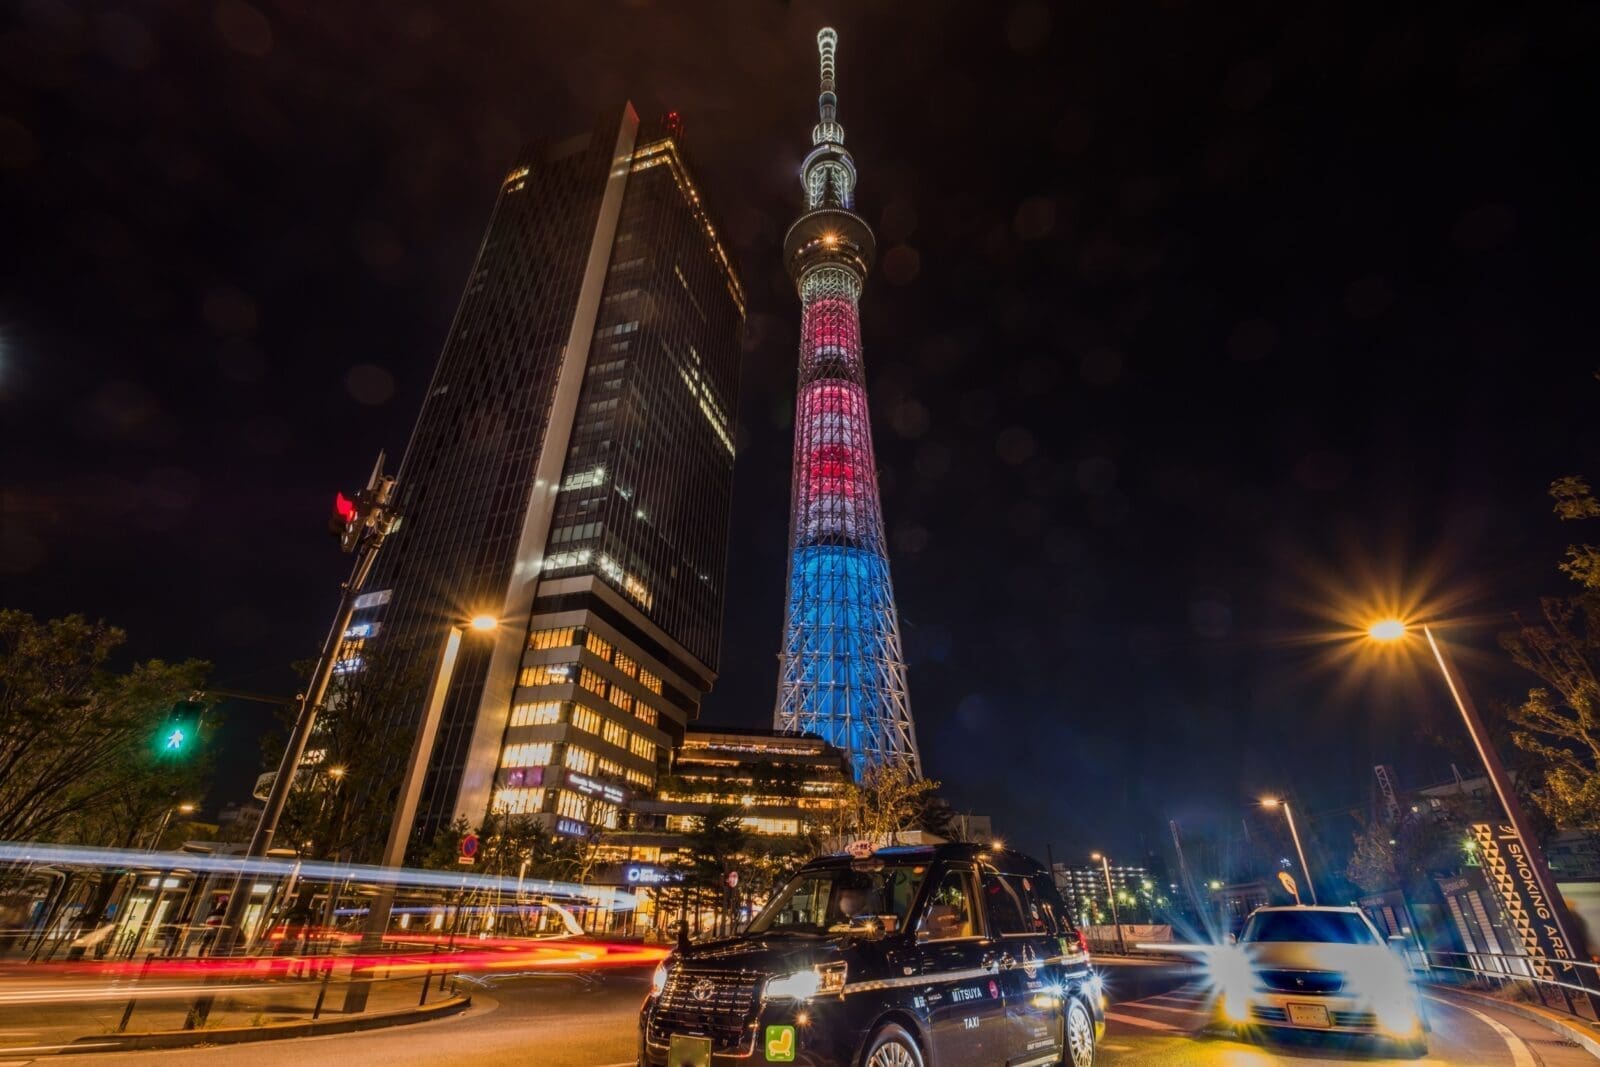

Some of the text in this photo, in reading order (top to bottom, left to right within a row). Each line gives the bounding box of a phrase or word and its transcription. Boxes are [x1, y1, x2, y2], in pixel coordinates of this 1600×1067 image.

[1508, 843, 1573, 972] SMOKING AREA
[952, 987, 982, 1002] MITSUYA
[964, 1016, 980, 1030] TAXI
